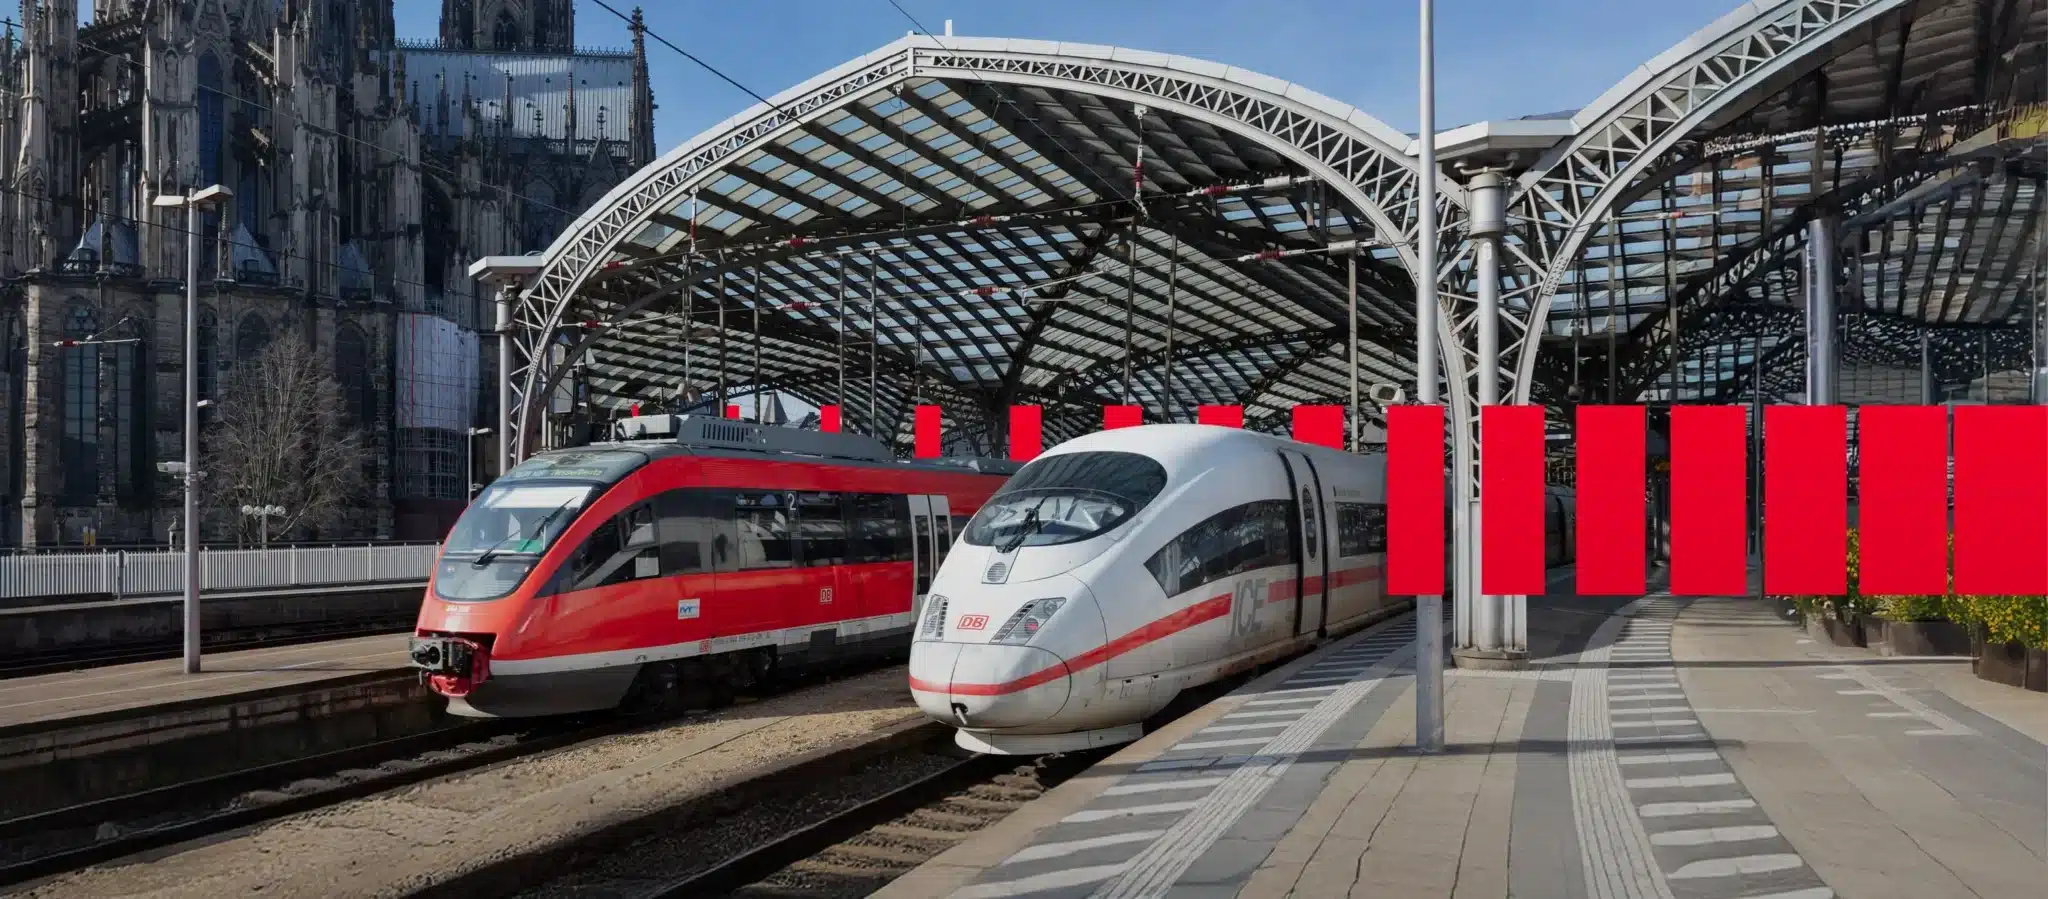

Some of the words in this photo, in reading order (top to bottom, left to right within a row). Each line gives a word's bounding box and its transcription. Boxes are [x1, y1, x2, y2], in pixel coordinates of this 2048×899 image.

[787, 493, 797, 511] 2
[821, 588, 832, 602] DB
[1231, 578, 1266, 637] ICE
[960, 616, 986, 629] DB
